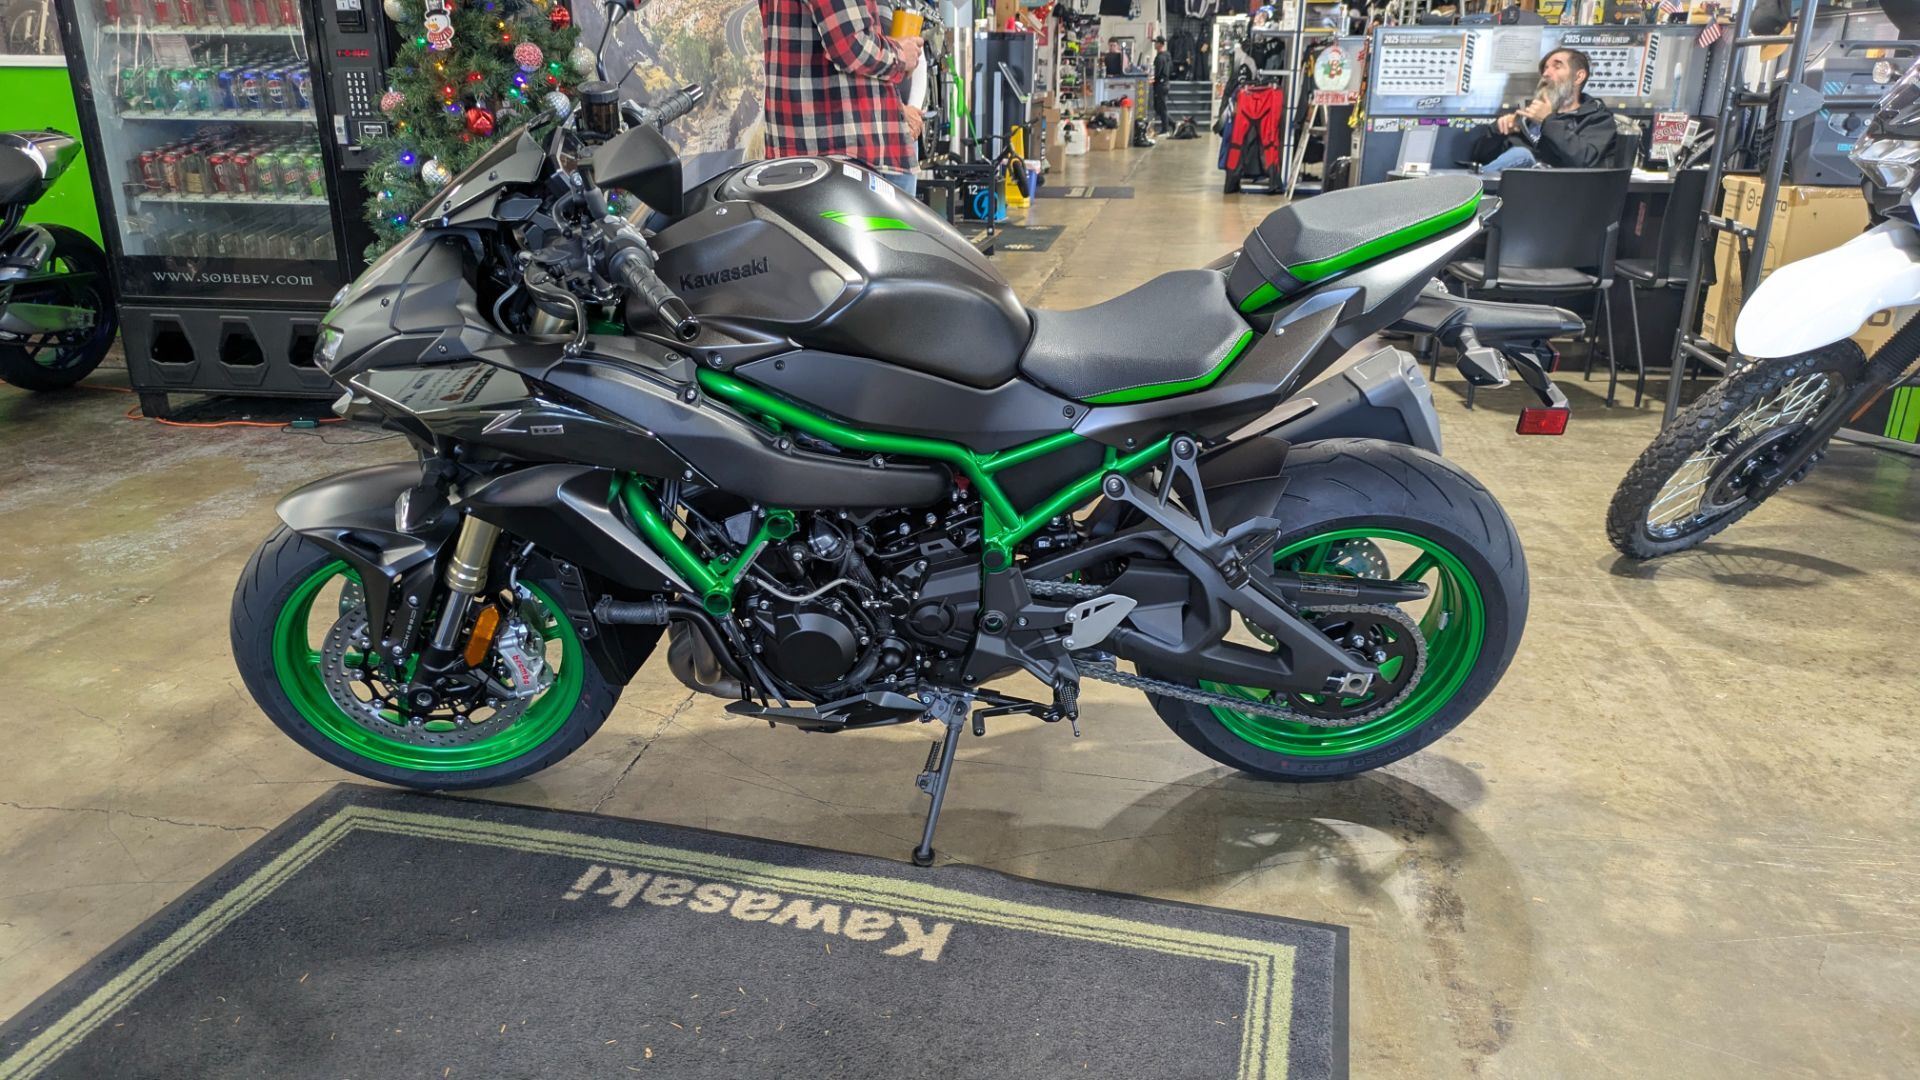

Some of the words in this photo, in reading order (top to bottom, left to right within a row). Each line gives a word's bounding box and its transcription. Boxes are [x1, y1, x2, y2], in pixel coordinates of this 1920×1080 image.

[1564, 34, 1581, 43] 2025
[1461, 34, 1475, 93] can-am
[1642, 34, 1659, 94] can-am
[1655, 122, 1686, 140] SOLD
[967, 184, 978, 195] 12
[680, 256, 768, 291] Kawasaki
[512, 654, 529, 685] brembo
[562, 864, 954, 962] Kawasaki
